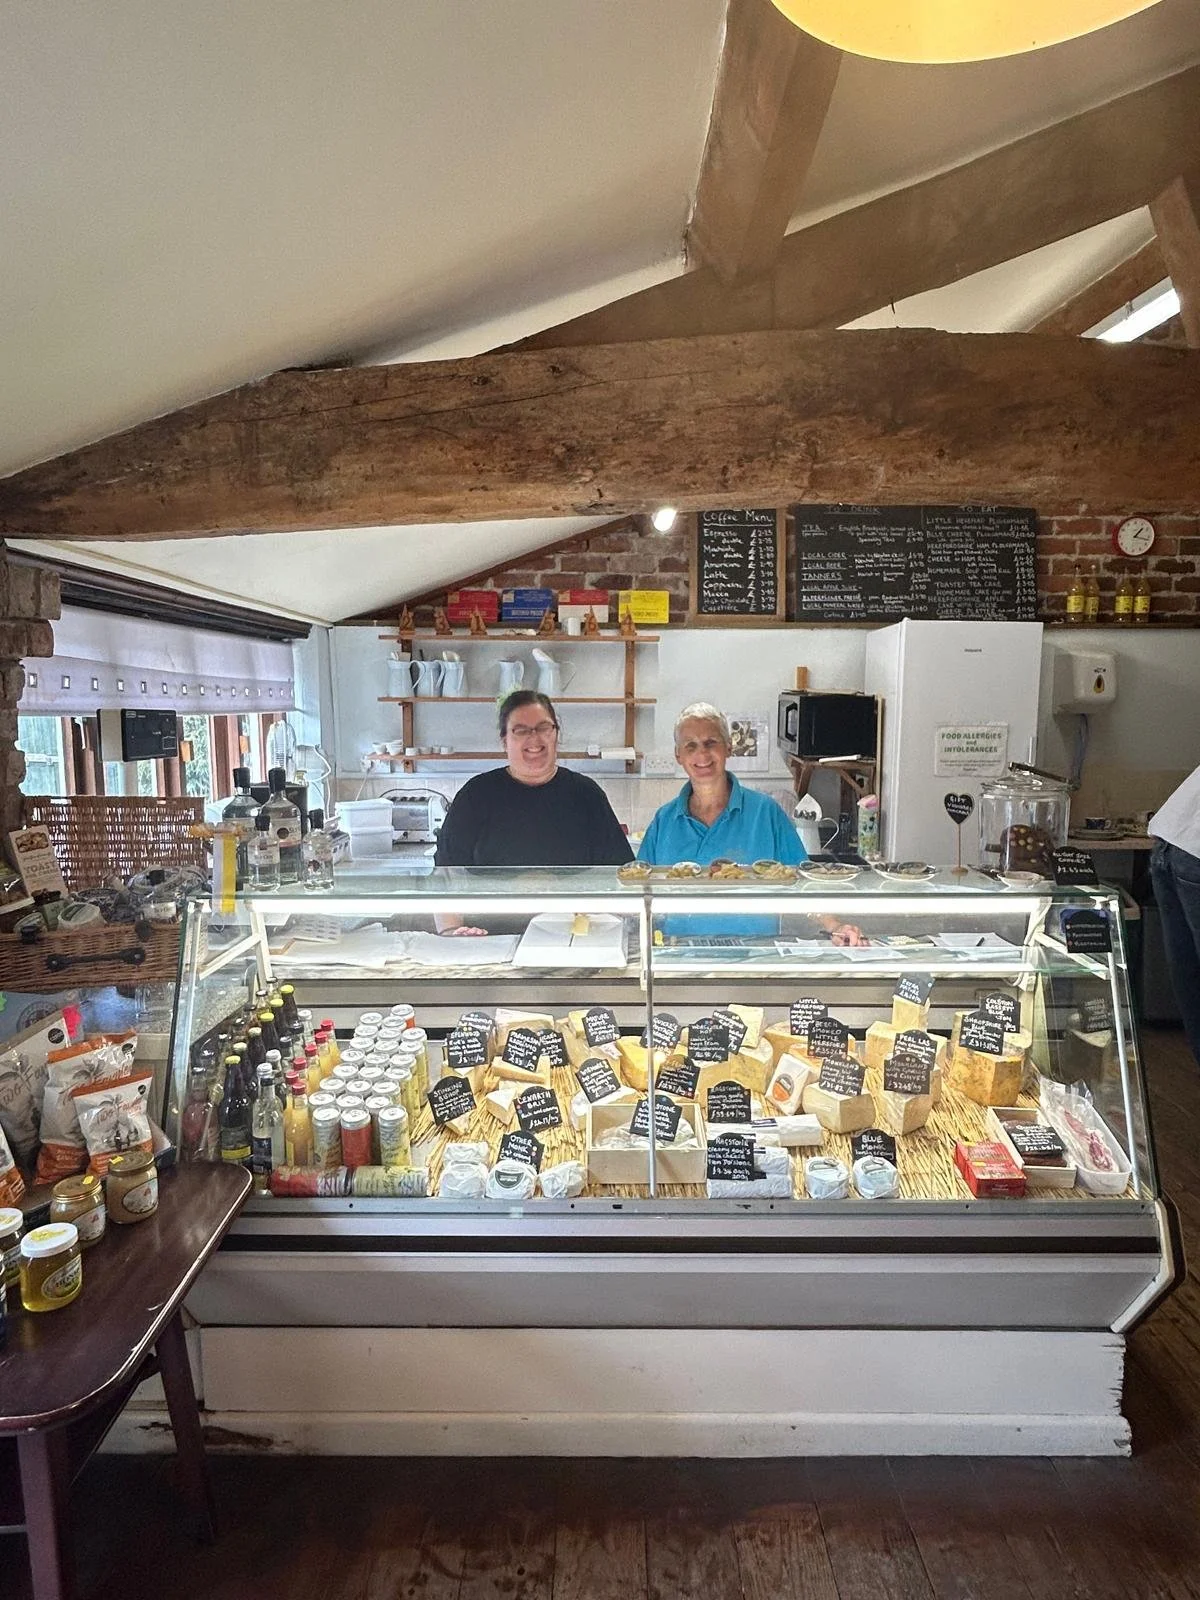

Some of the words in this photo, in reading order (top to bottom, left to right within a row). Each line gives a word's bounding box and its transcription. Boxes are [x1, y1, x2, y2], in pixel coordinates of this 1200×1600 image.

[703, 512, 738, 523] Coffee
[704, 570, 728, 580] Latte
[942, 732, 962, 740] FOOD
[962, 732, 1002, 740] ALLERGIES
[526, 1098, 546, 1110] BRIE
[642, 1100, 676, 1114] DSTONE
[510, 1134, 533, 1148] OTHER
[862, 1134, 884, 1144] BLUE
[507, 1142, 529, 1154] MONK
